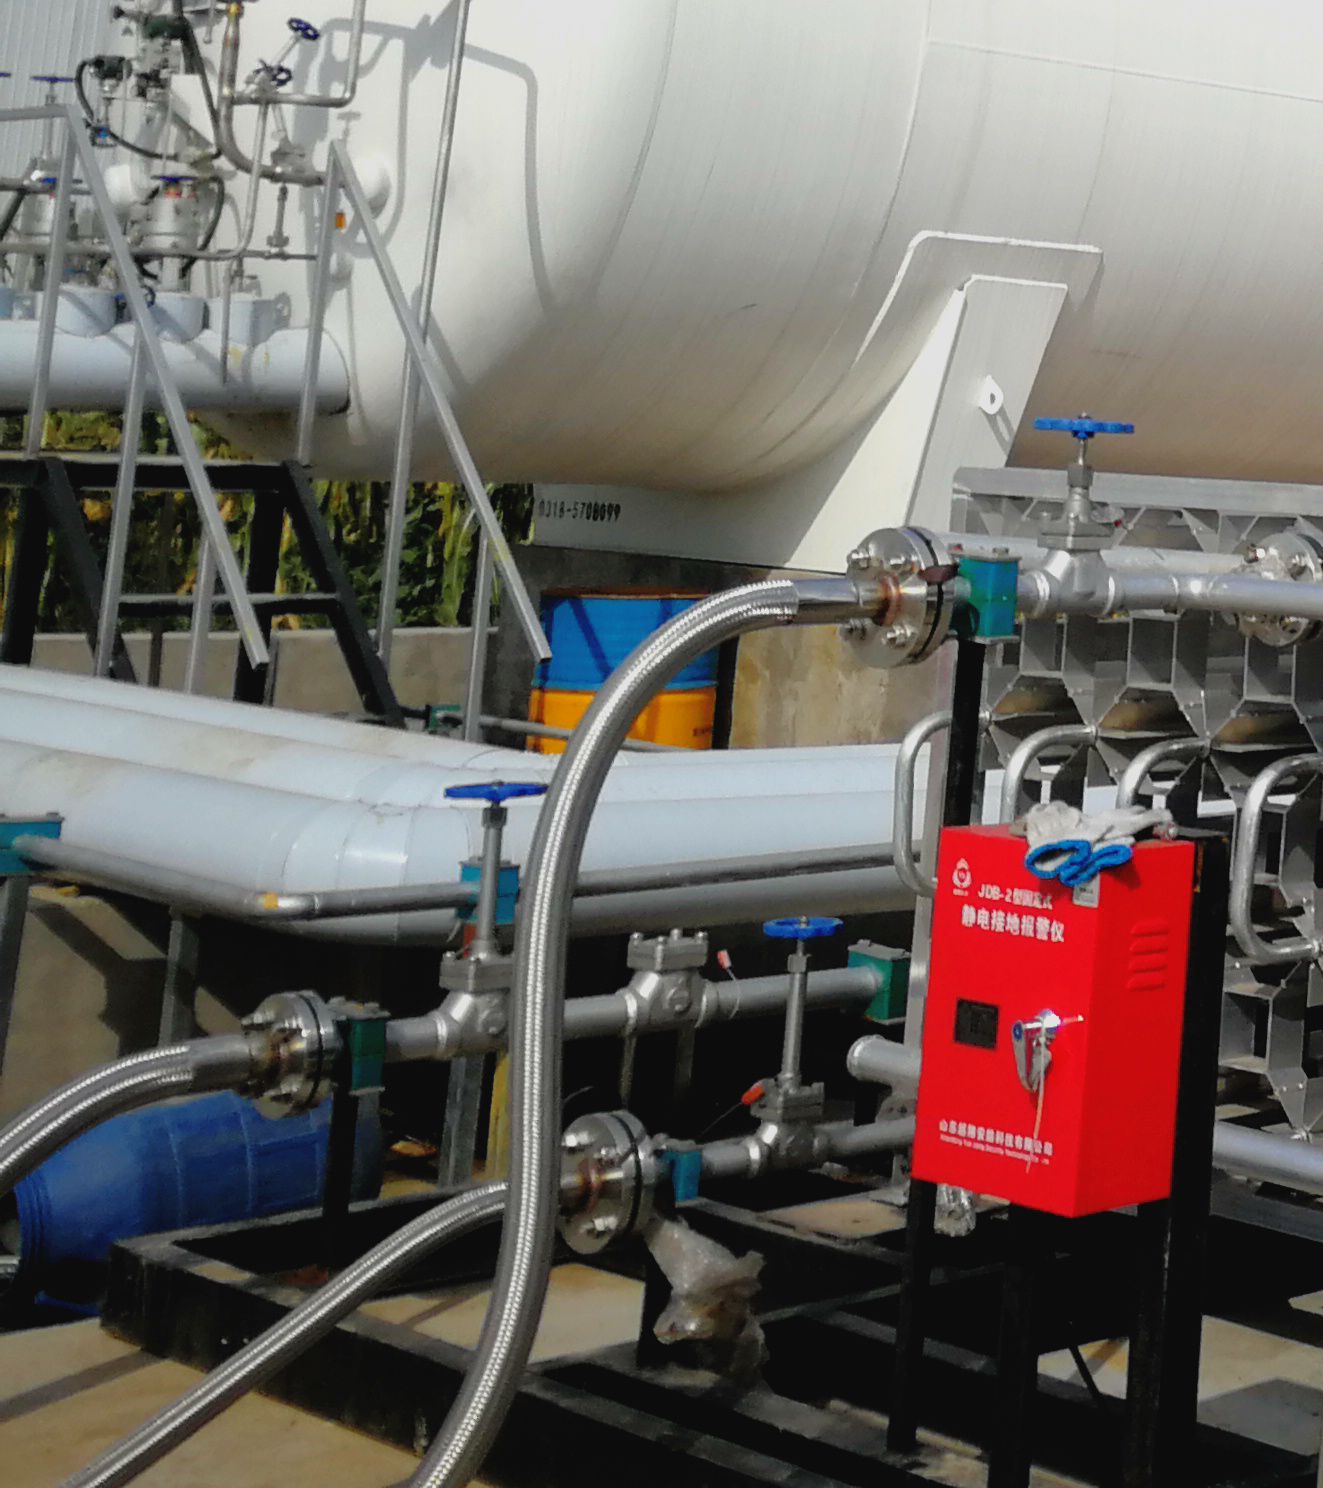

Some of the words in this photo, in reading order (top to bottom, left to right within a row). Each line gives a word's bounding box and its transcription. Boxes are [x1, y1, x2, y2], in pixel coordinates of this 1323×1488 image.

[961, 903, 1065, 942] 静电接地报警仪
